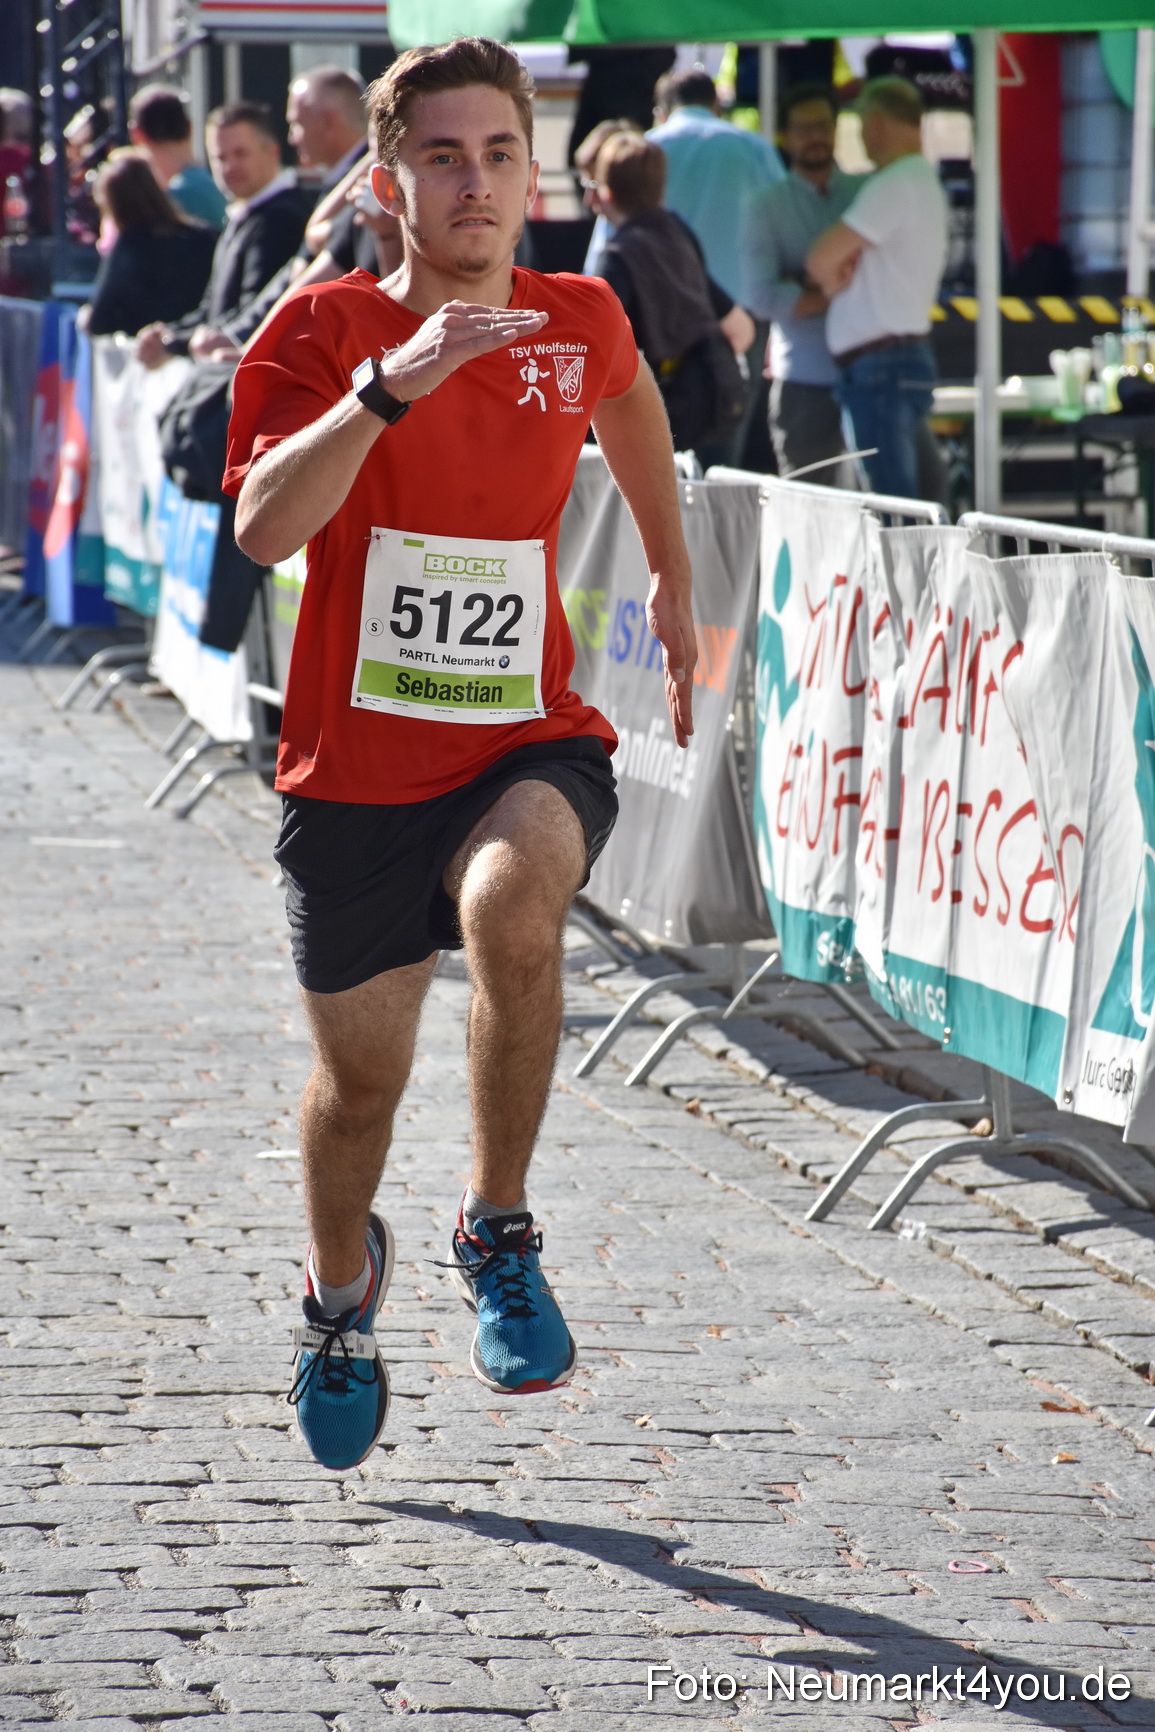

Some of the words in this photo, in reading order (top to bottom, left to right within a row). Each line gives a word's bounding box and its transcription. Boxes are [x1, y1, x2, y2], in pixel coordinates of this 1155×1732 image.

[509, 346, 531, 359] TSV
[534, 342, 588, 355] Wolfstein
[559, 404, 584, 414] Laufsport
[424, 553, 507, 577] BOCK
[422, 572, 449, 581] inspired
[389, 585, 524, 647] 5122
[371, 622, 378, 632] S
[399, 648, 439, 664] PARTL
[441, 654, 495, 667] Neumarkt
[395, 672, 503, 703] Sebastian
